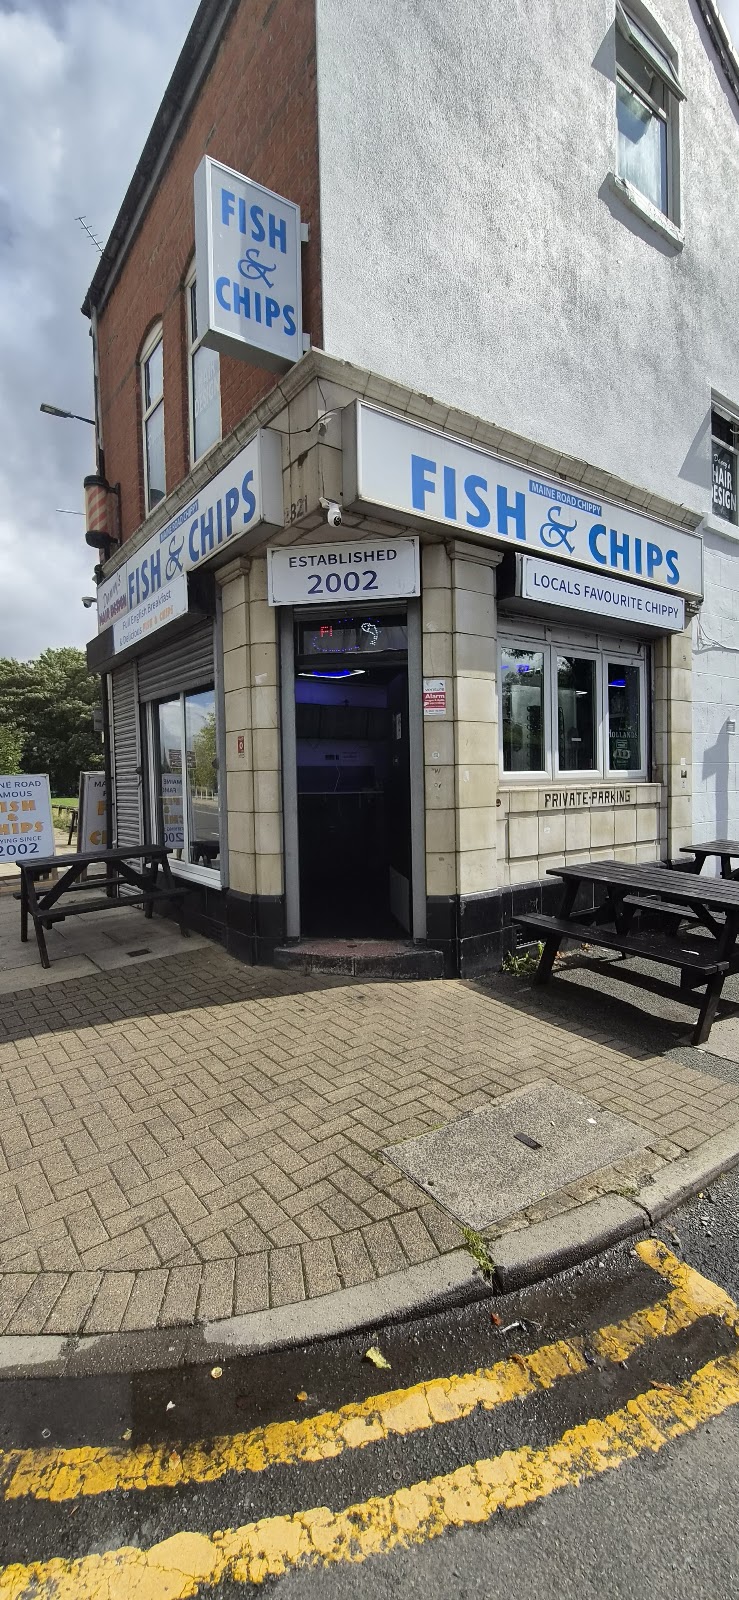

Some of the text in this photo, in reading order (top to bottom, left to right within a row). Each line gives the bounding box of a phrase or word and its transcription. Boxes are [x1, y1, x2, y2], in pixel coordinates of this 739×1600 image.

[221, 188, 287, 254] FISH
[237, 248, 277, 289] &
[215, 276, 296, 336] CHIPS
[712, 464, 732, 490] HAIR
[532, 482, 601, 515] MAINE ROAD CHIPPY
[711, 484, 737, 511] ESIGN
[411, 454, 680, 586] FISH & CHIPS
[128, 470, 256, 610] FISH & CHIPS
[289, 549, 397, 568] ESTABLISHED
[307, 570, 379, 595] 2002
[533, 572, 679, 619] LOCALS FAVOURITE CHIPPY
[122, 589, 172, 631] Full English Breakfast
[14, 780, 42, 788] ROAD
[544, 790, 631, 808] PRIVATE PARKING
[19, 835, 42, 843] SINCE
